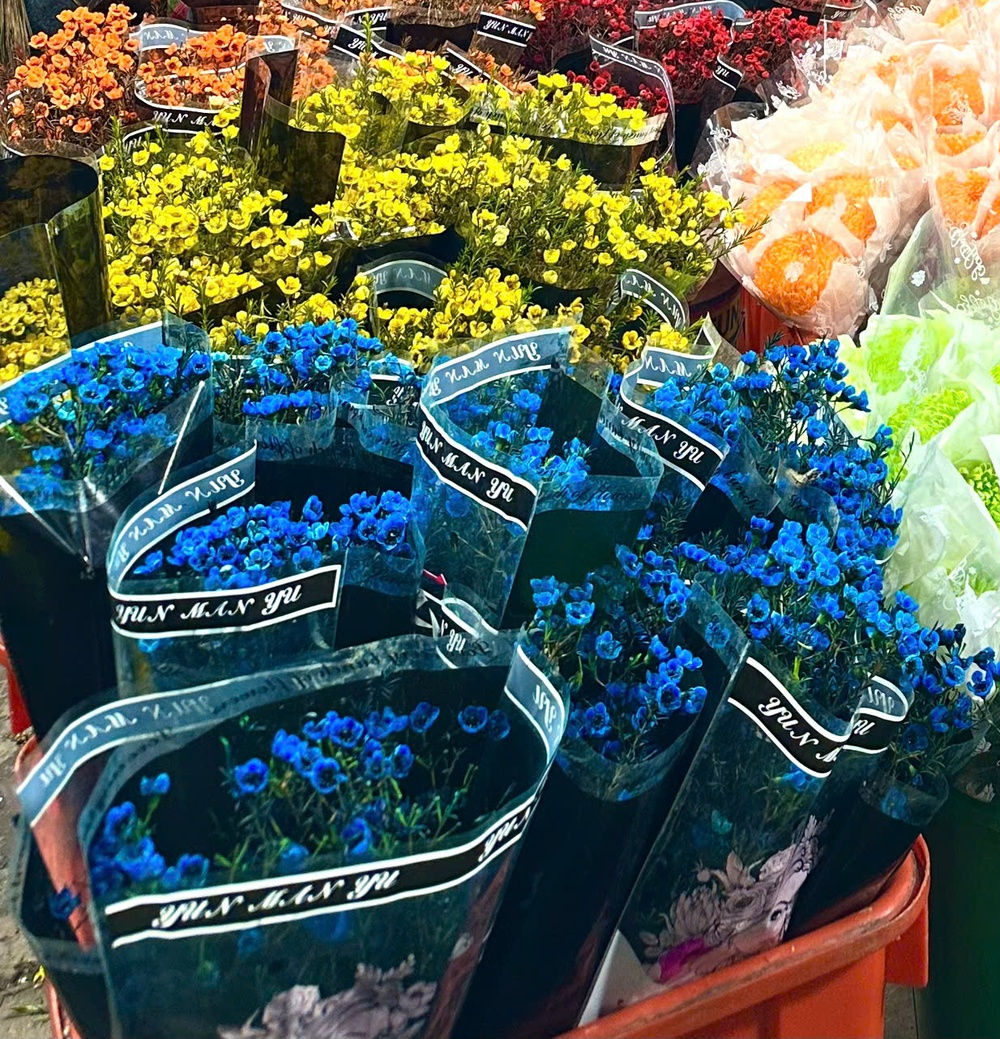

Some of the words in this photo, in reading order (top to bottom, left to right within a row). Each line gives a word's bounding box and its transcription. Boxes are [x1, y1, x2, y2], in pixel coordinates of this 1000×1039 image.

[674, 440, 706, 465] YU
[441, 453, 485, 483] MAN
[486, 477, 514, 502] YU
[115, 604, 175, 625] YUN
[180, 598, 255, 619] MAN
[261, 584, 302, 616] YU
[758, 696, 820, 746] YUN
[151, 895, 244, 928] YUN
[248, 879, 345, 912] MAN
[346, 869, 400, 900] YU
